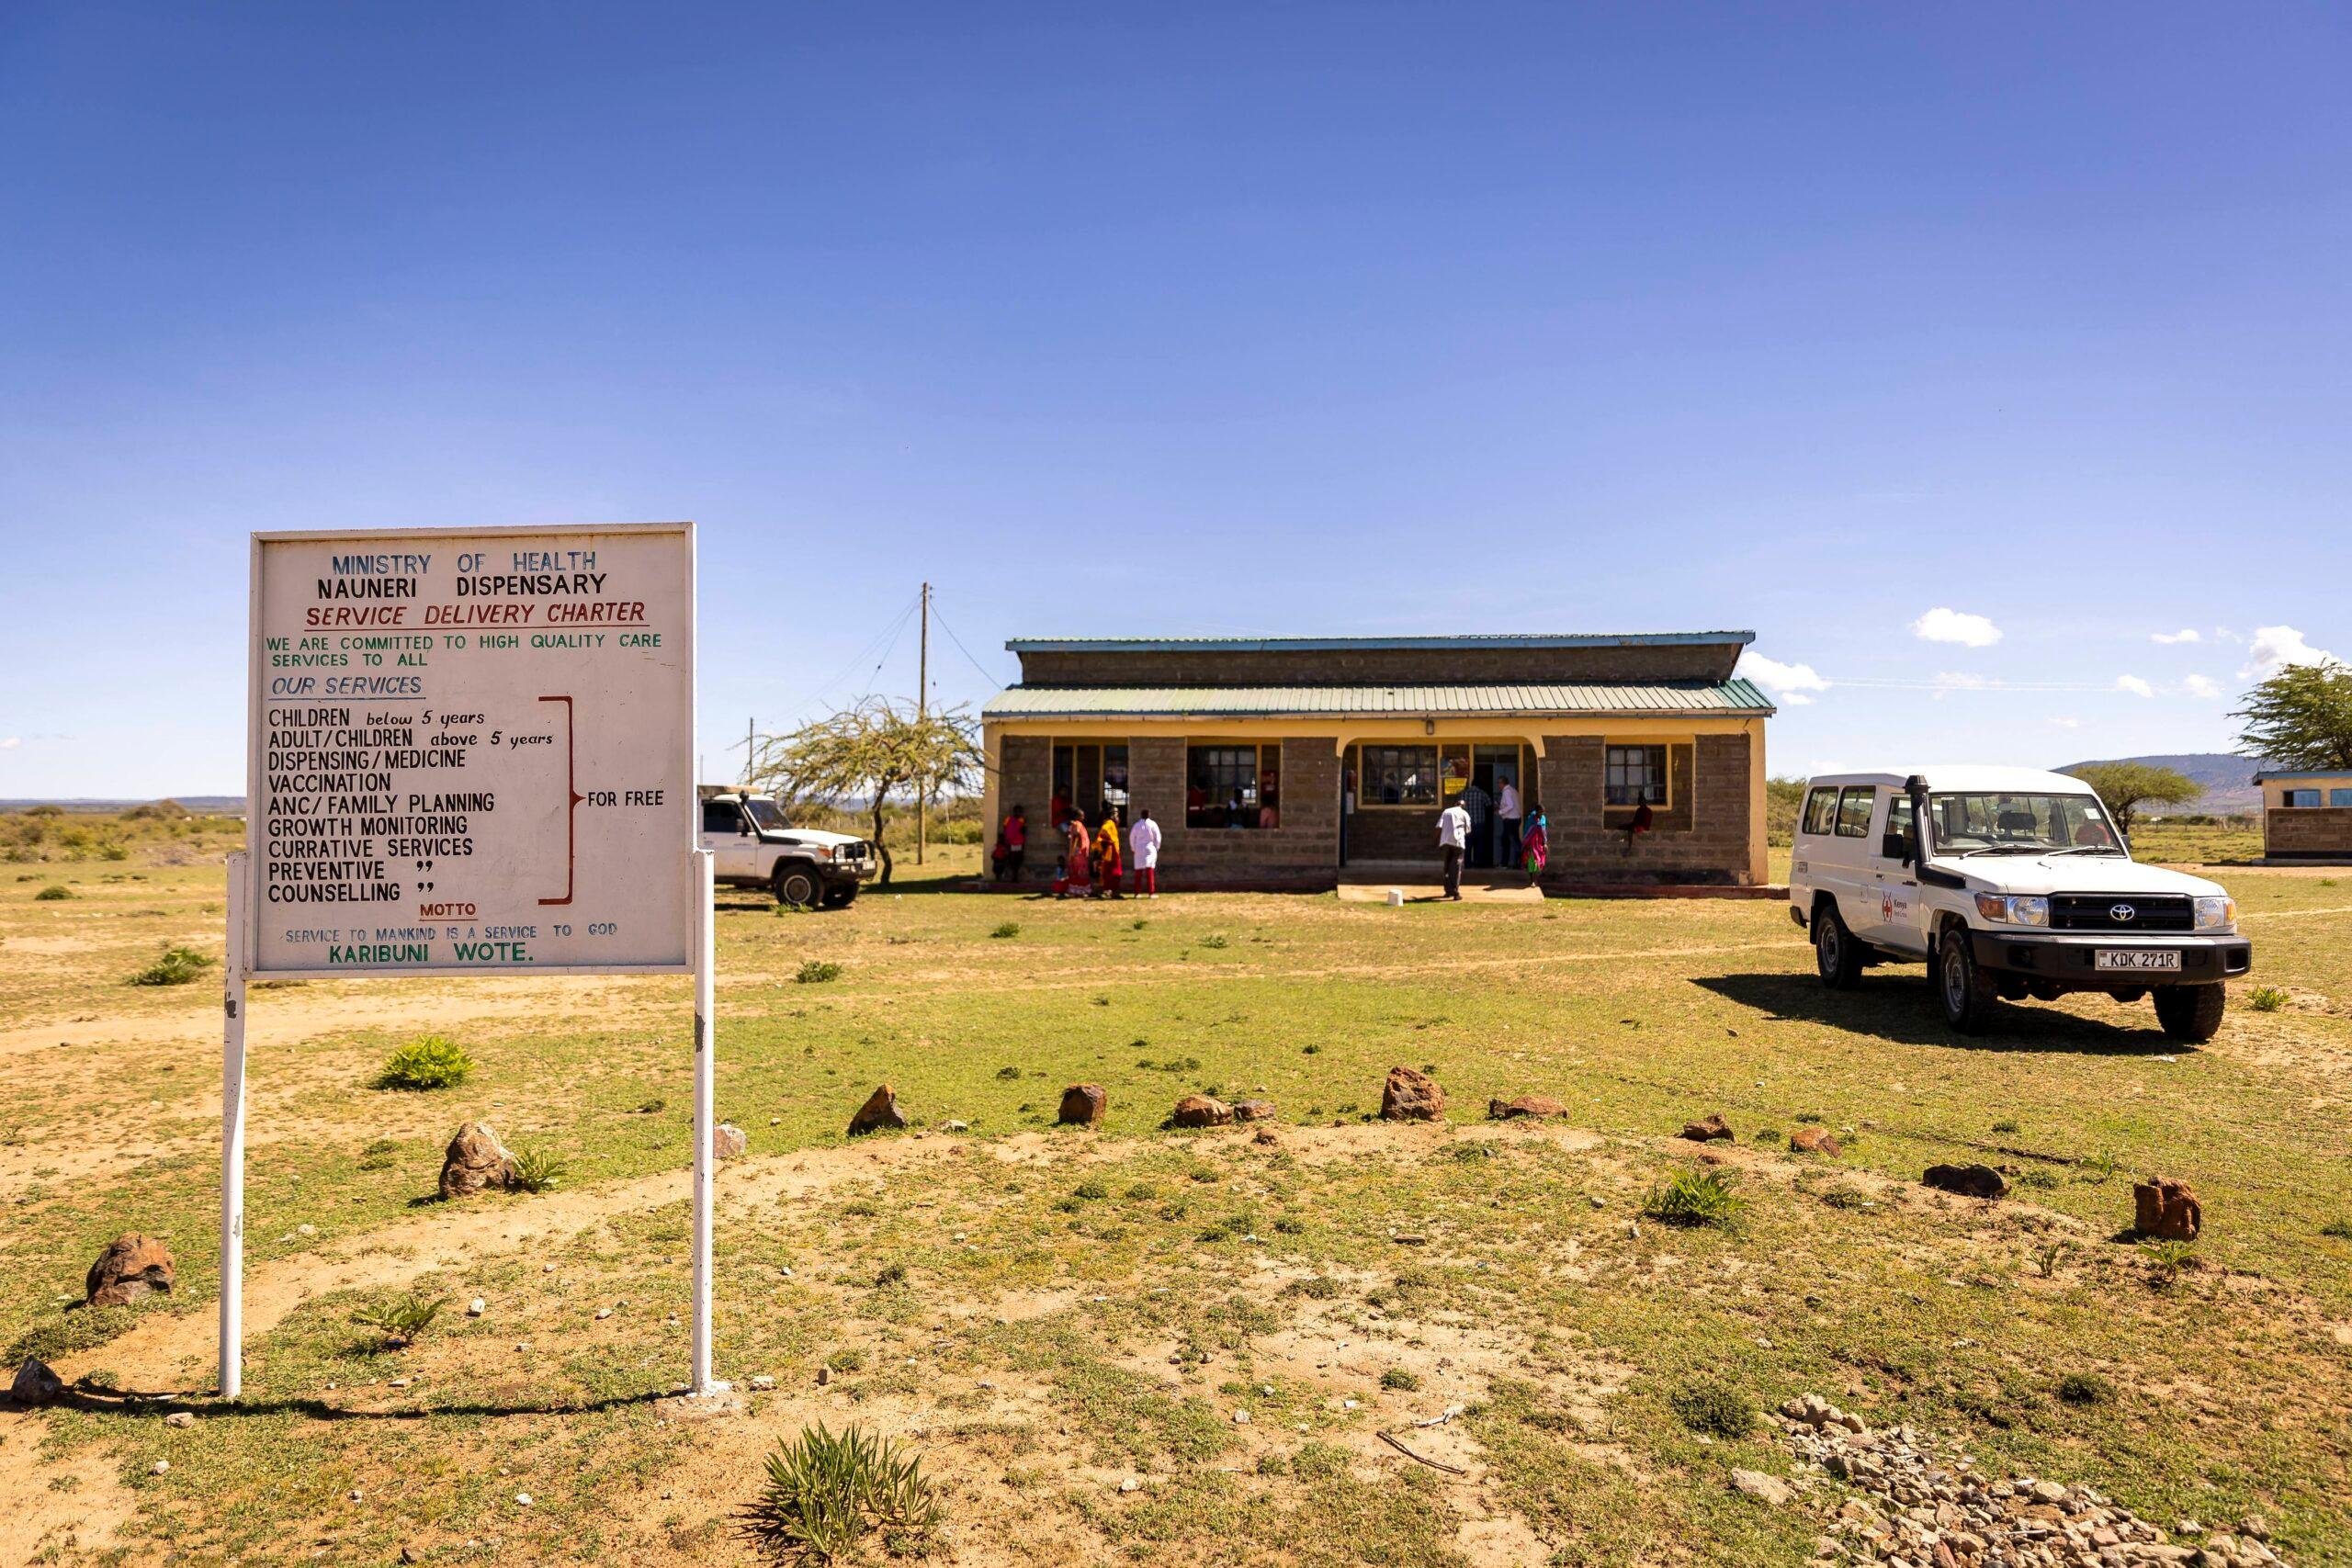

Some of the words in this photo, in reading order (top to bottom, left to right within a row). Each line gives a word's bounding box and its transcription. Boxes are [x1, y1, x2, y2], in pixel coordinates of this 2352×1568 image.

[333, 555, 431, 575] MINISTRY
[458, 554, 485, 572] OF
[514, 551, 595, 571] HEALTH
[318, 578, 415, 599] NAUNERI
[458, 573, 606, 596] DISPENSARY
[307, 606, 407, 626] SERVICE
[424, 604, 535, 624] DELIVERY
[548, 602, 644, 622] CHARTER
[266, 637, 289, 650] WE
[300, 637, 328, 650] ARE
[341, 637, 433, 649] COMMITTED
[443, 636, 466, 649] TO
[481, 636, 518, 649] HIGH
[531, 635, 605, 648] QUALITY
[619, 634, 662, 647] CARE
[272, 654, 347, 667] SERVICES
[362, 654, 382, 666] TO
[397, 653, 427, 666] ALL
[272, 677, 315, 694] OUR
[325, 677, 421, 694] SERVICES
[269, 708, 349, 727] CHILDREN
[367, 712, 413, 725] below
[422, 710, 433, 724] 5
[441, 714, 484, 728] years
[431, 732, 477, 746] above
[491, 731, 503, 745] 5
[511, 736, 552, 750] years
[268, 773, 390, 793] VACCINATION
[329, 795, 398, 814] FAMILY
[410, 793, 494, 813] PLANNING
[588, 792, 616, 807] FOR
[626, 790, 663, 806] FREE
[268, 818, 352, 837] GROWTH
[361, 816, 467, 835] MONITORING
[268, 840, 373, 858] CURRATIVE
[388, 838, 472, 857] SERVICES
[269, 861, 384, 881] PREVENTIVE
[268, 883, 400, 903] COUNSELLING
[421, 903, 476, 916] MOTTO
[1894, 898, 1907, 909] Kenya
[286, 930, 340, 942] SERVICE
[350, 930, 366, 942] TO
[377, 928, 435, 941] MANKIND
[447, 927, 458, 939] IS
[468, 927, 476, 939] A
[485, 926, 537, 939] SERVICE
[553, 925, 571, 937] TO
[588, 923, 617, 935] GOD
[330, 944, 428, 963] KARIBUNI
[454, 942, 533, 961] WOTE.
[2110, 953, 2136, 967] KDK
[2142, 953, 2174, 967] 271R
